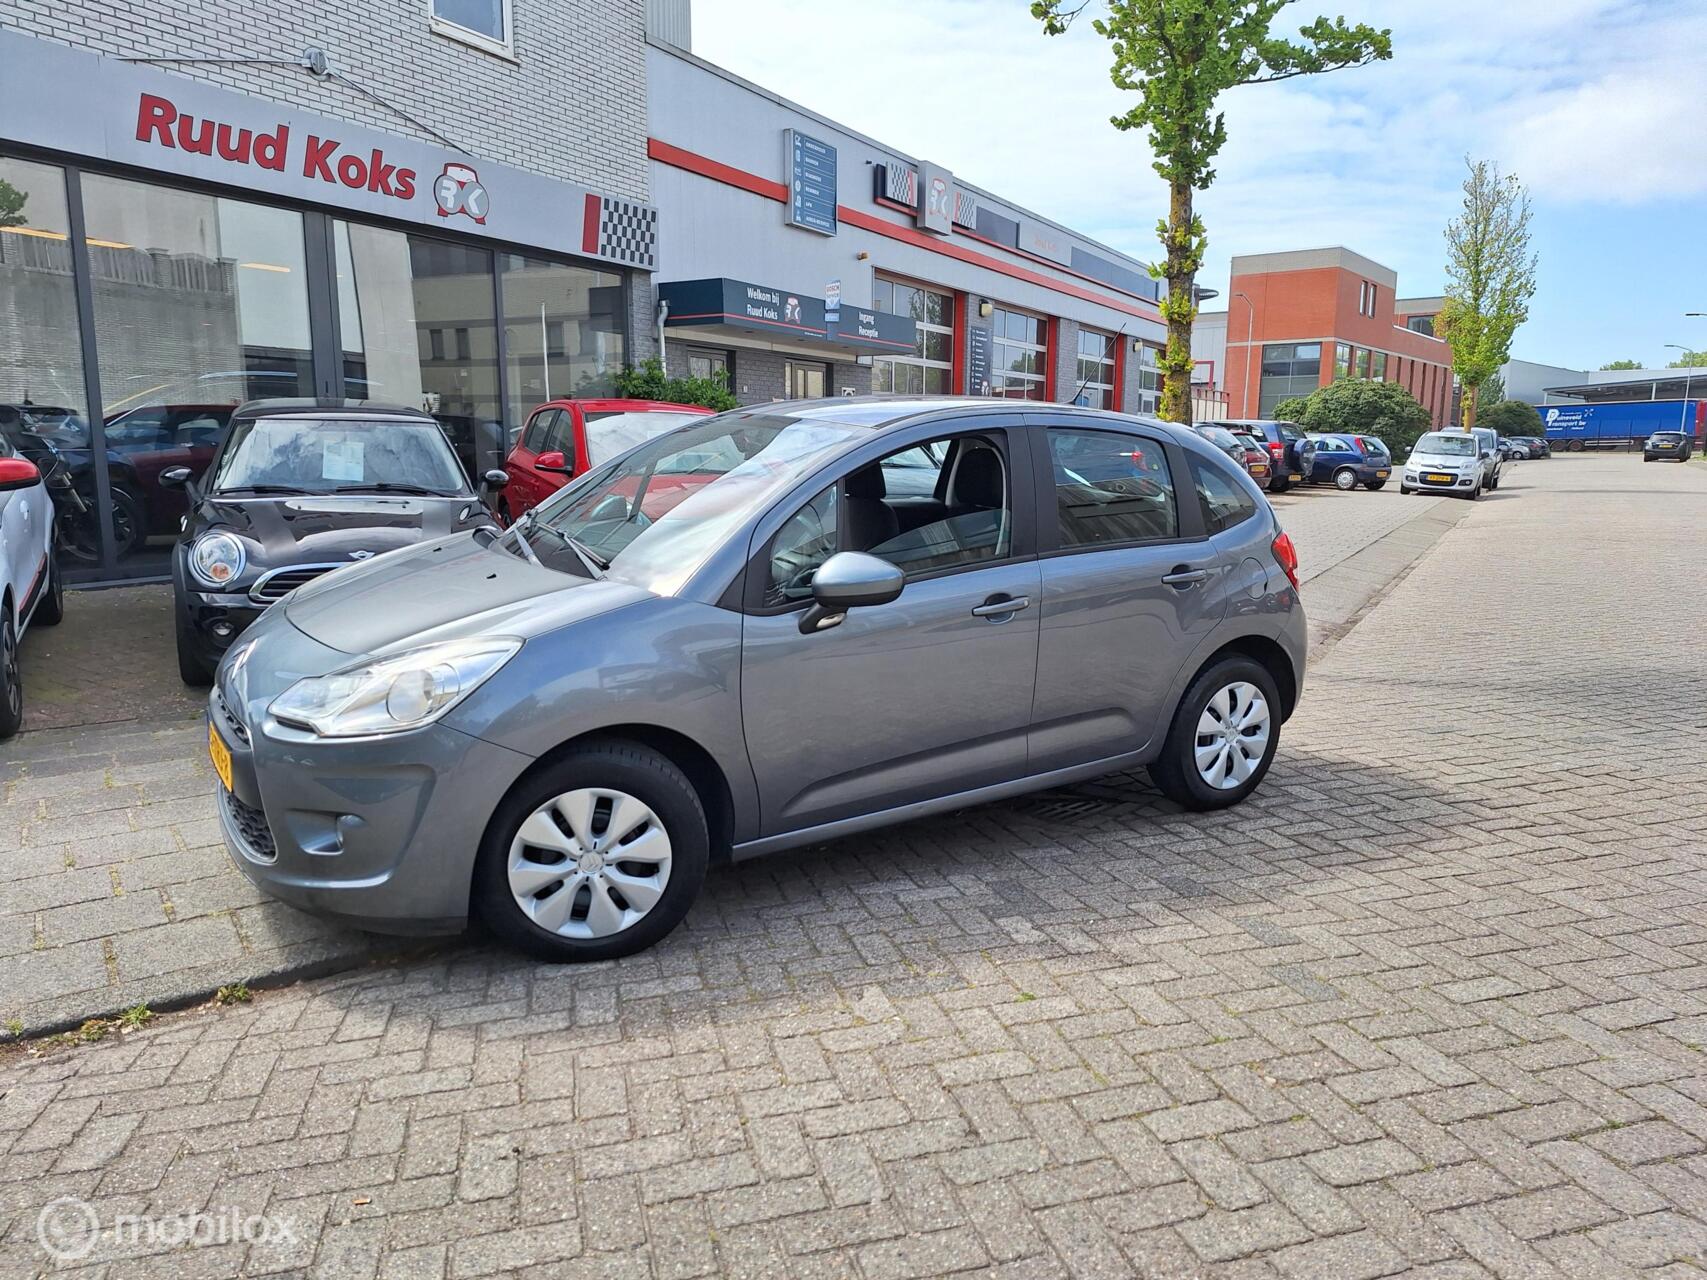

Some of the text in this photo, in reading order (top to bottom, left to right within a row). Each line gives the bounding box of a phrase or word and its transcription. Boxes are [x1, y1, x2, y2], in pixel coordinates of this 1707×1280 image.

[136, 93, 416, 200] Ruud Koks
[747, 287, 780, 306] Welkom bij
[747, 304, 778, 320] Ruud Koks
